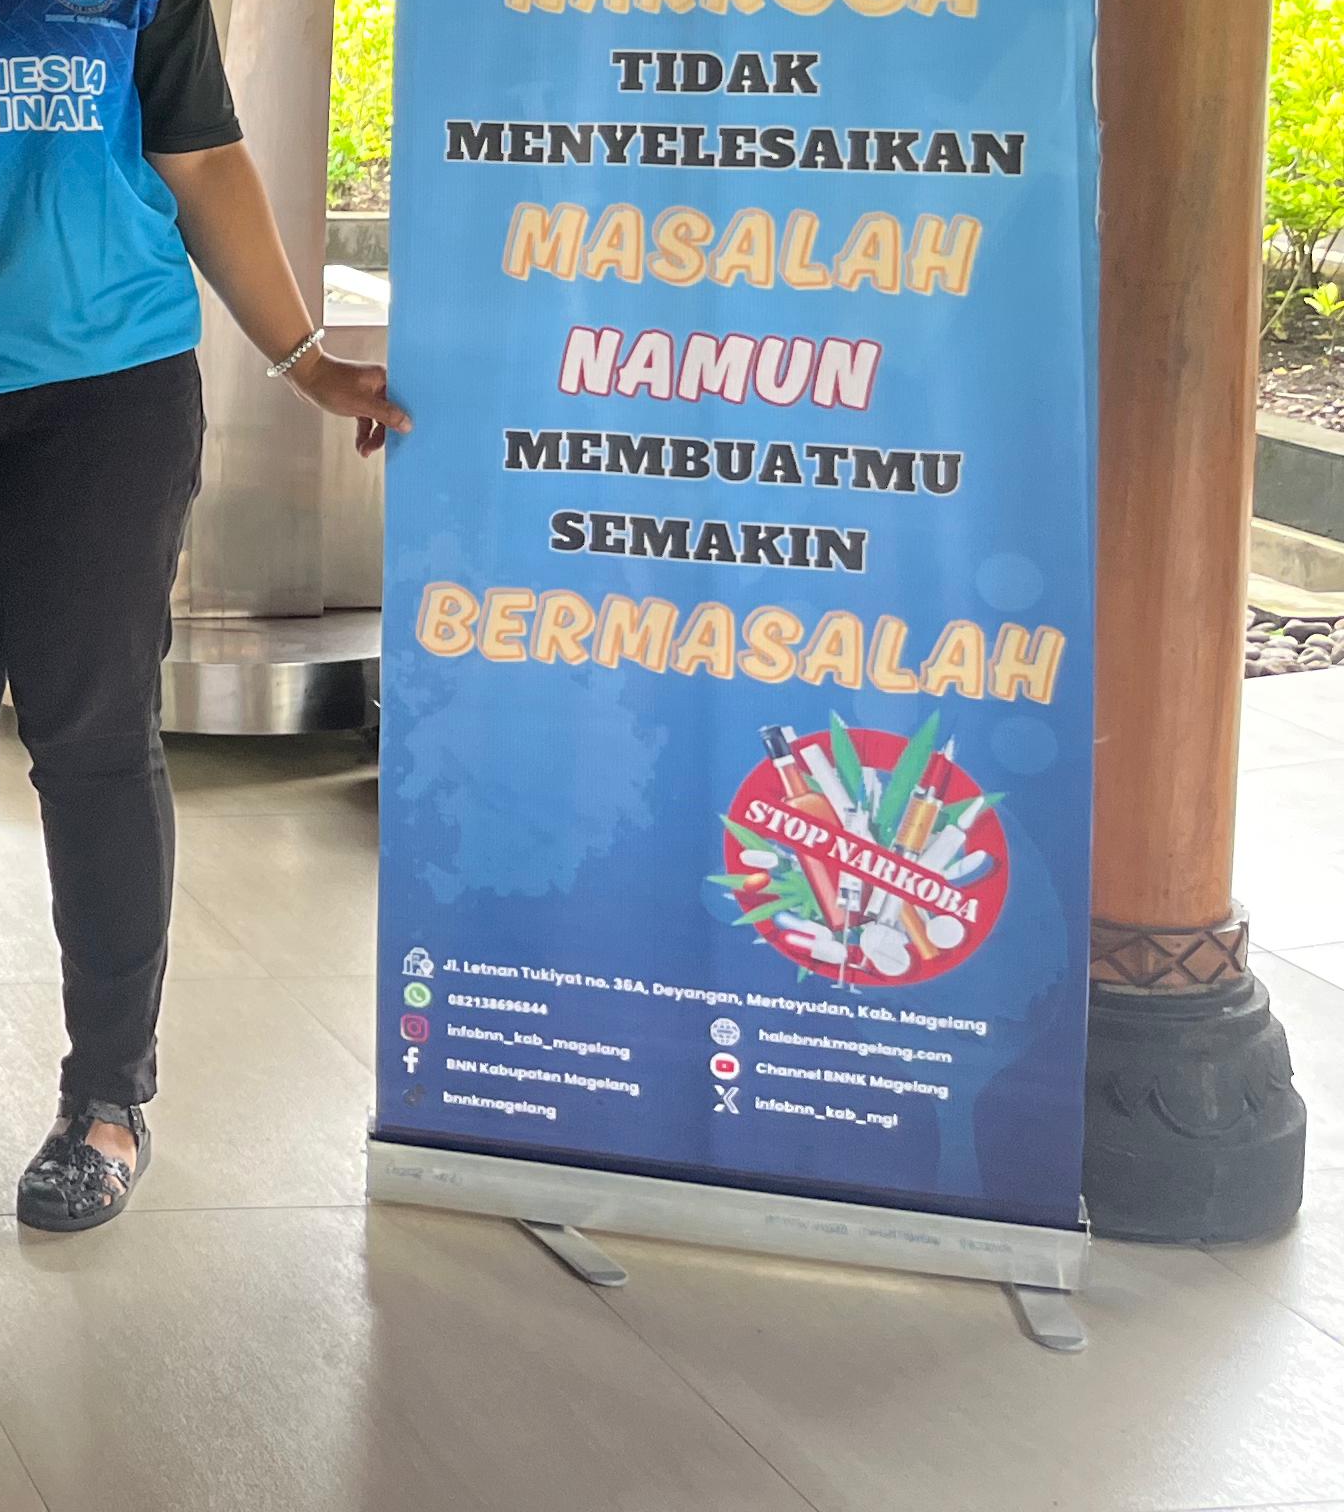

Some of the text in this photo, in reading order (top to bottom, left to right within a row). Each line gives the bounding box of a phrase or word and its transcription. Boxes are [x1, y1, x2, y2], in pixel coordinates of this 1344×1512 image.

[611, 50, 820, 96] TIDAK
[444, 120, 1026, 176] MENYELESAIKAN
[502, 203, 983, 296] MASALAH
[558, 326, 883, 411] NAMUN
[503, 429, 963, 496] MEMBUATMU
[549, 511, 868, 573] SEMAKIN
[415, 581, 1067, 705] BERMASALAH
[743, 798, 980, 924] STOP NARKOBA
[464, 961, 519, 979] Letnan
[521, 967, 582, 987] Tukiyat
[747, 993, 855, 1018] Mertoyudan,
[858, 1005, 897, 1023] Kab.
[900, 1011, 988, 1036] Magelang
[446, 1058, 641, 1096] BNN Kabupaten Magelang
[755, 1061, 950, 1099] Channel BNNK Magelang
